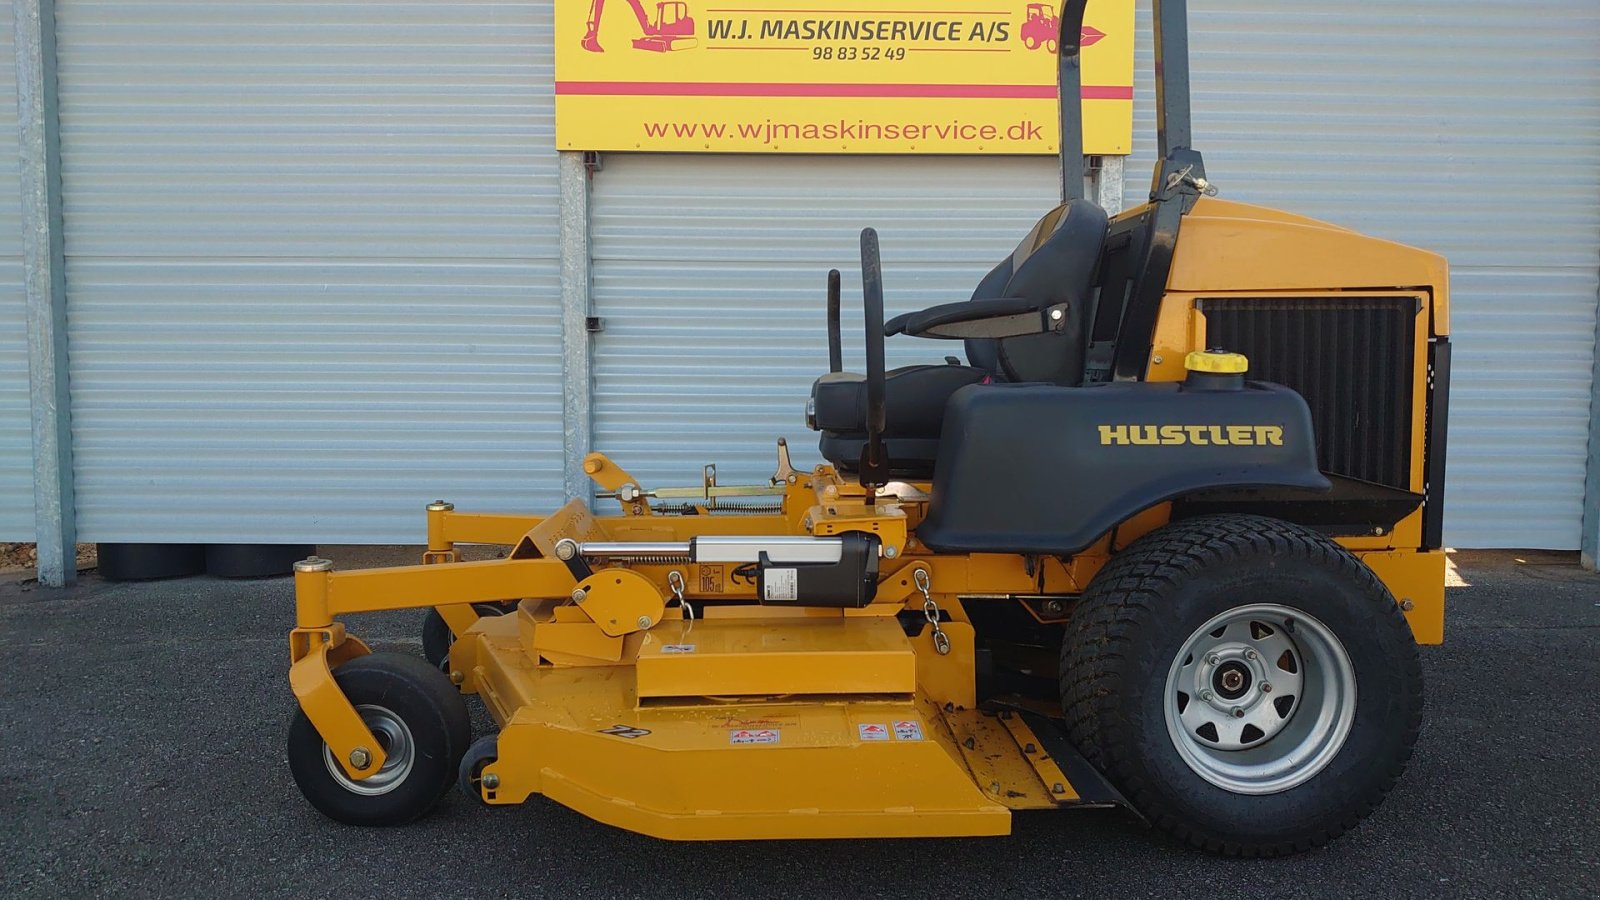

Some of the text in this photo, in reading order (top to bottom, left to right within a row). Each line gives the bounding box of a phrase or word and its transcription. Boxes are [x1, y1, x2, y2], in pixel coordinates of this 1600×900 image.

[707, 19, 1010, 42] W.J. MASKINSERVICE A/S
[812, 47, 906, 61] 98 83 52 49
[643, 119, 1043, 144] www.wjmaskinservice.dk
[1098, 425, 1284, 446] HUSTLER
